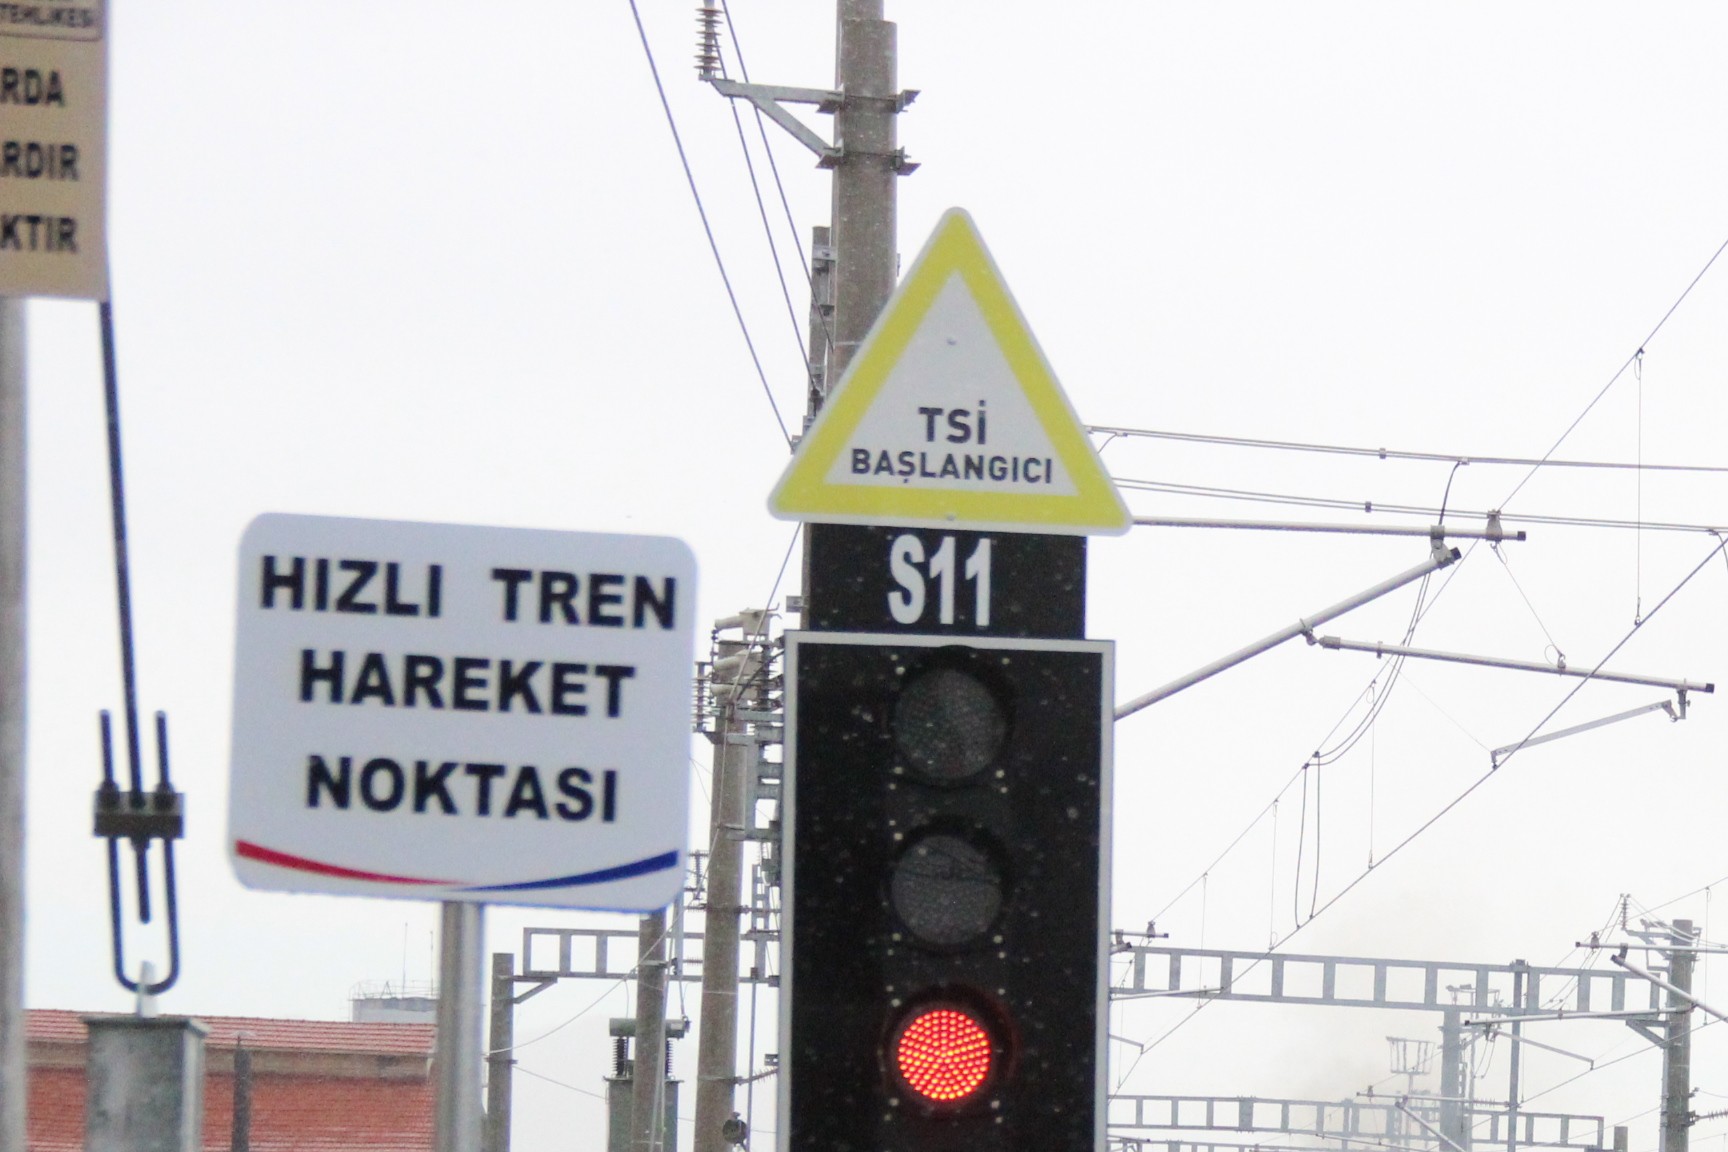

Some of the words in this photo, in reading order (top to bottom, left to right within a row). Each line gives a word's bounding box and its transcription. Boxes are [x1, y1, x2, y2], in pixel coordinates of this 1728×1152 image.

[918, 400, 987, 445] TSİ
[851, 448, 1053, 483] BAŞLANGICI
[260, 554, 443, 618] HIZLI
[491, 567, 677, 630] TREN
[887, 534, 992, 627] S11
[299, 648, 636, 718] HAREKET
[305, 754, 618, 823] NOKTASI
